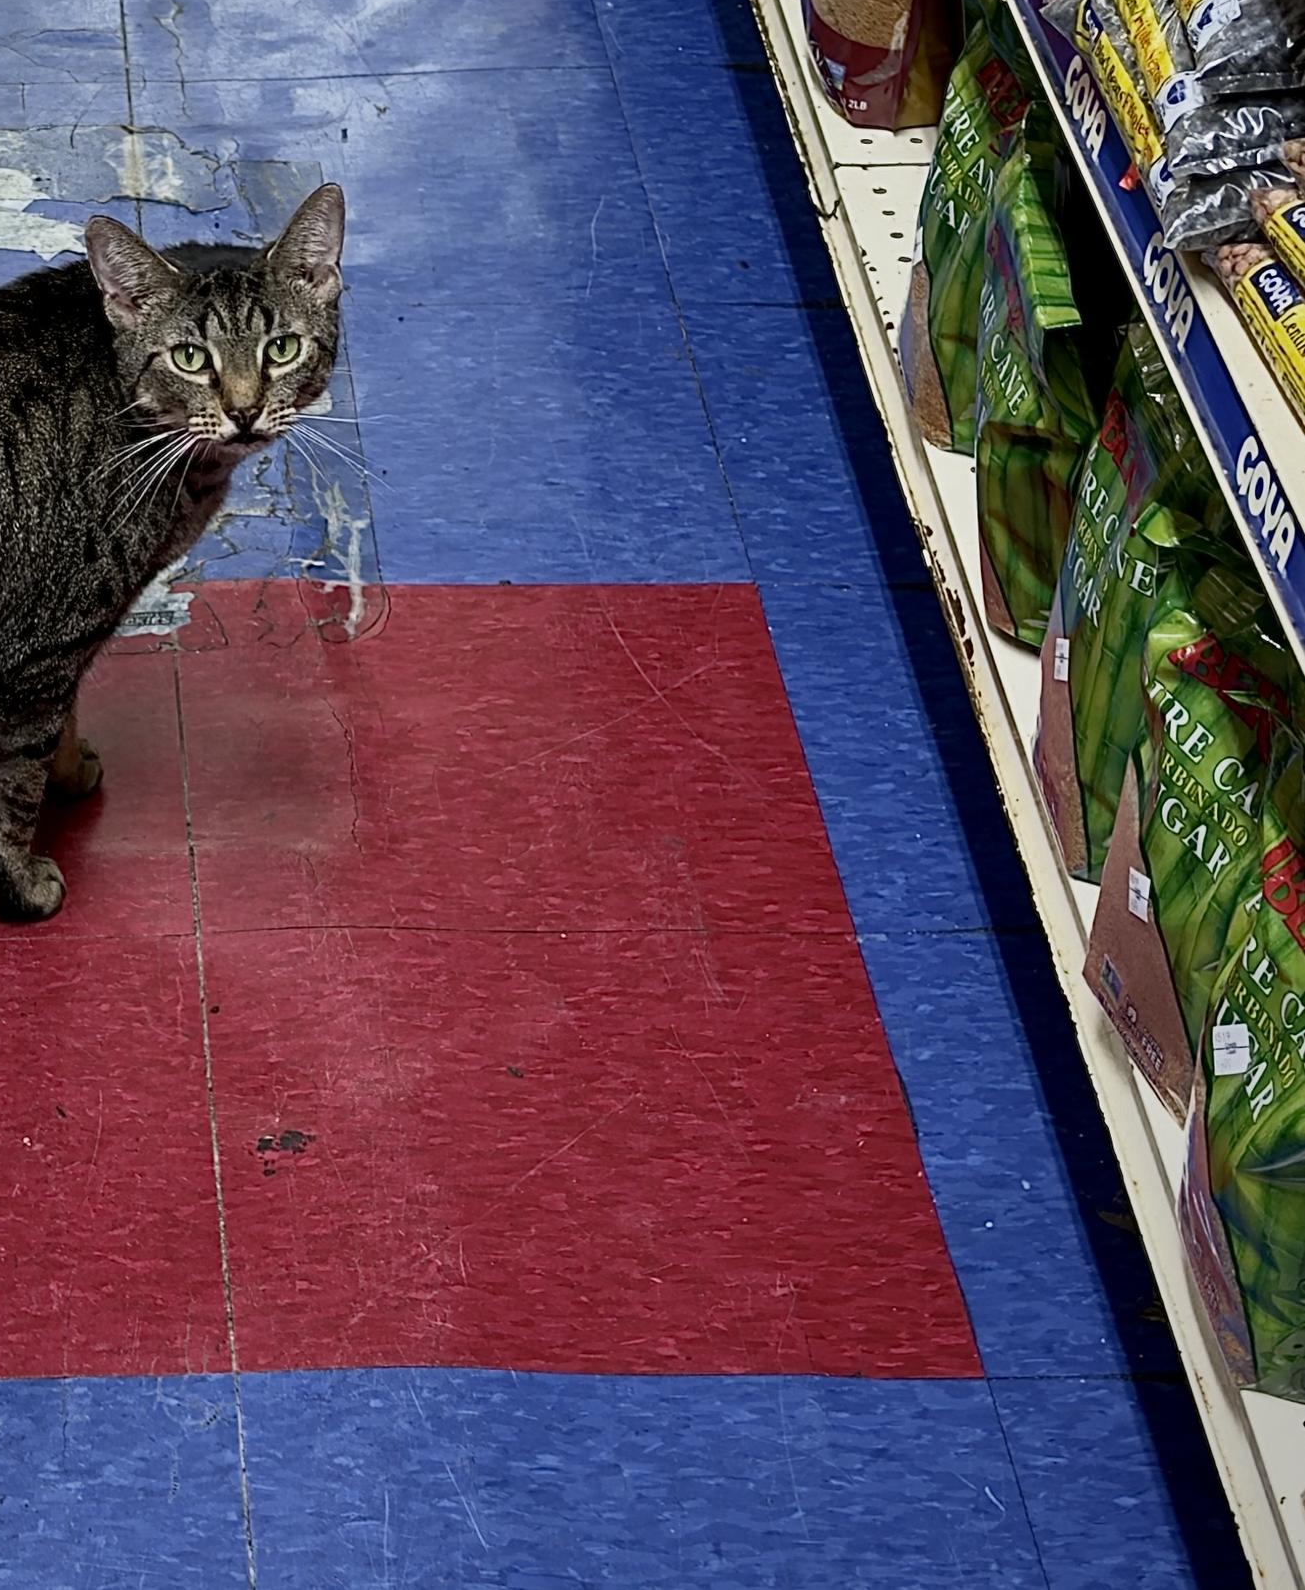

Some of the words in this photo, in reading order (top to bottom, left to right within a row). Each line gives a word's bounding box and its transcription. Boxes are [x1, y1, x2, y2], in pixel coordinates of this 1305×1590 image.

[1063, 55, 1107, 156] GOYA
[1143, 231, 1196, 354] GOYA
[1258, 267, 1294, 318] GOYA
[991, 333, 1028, 417] CANE
[1236, 435, 1297, 580] GOYA
[1161, 745, 1248, 848] RBINADO
